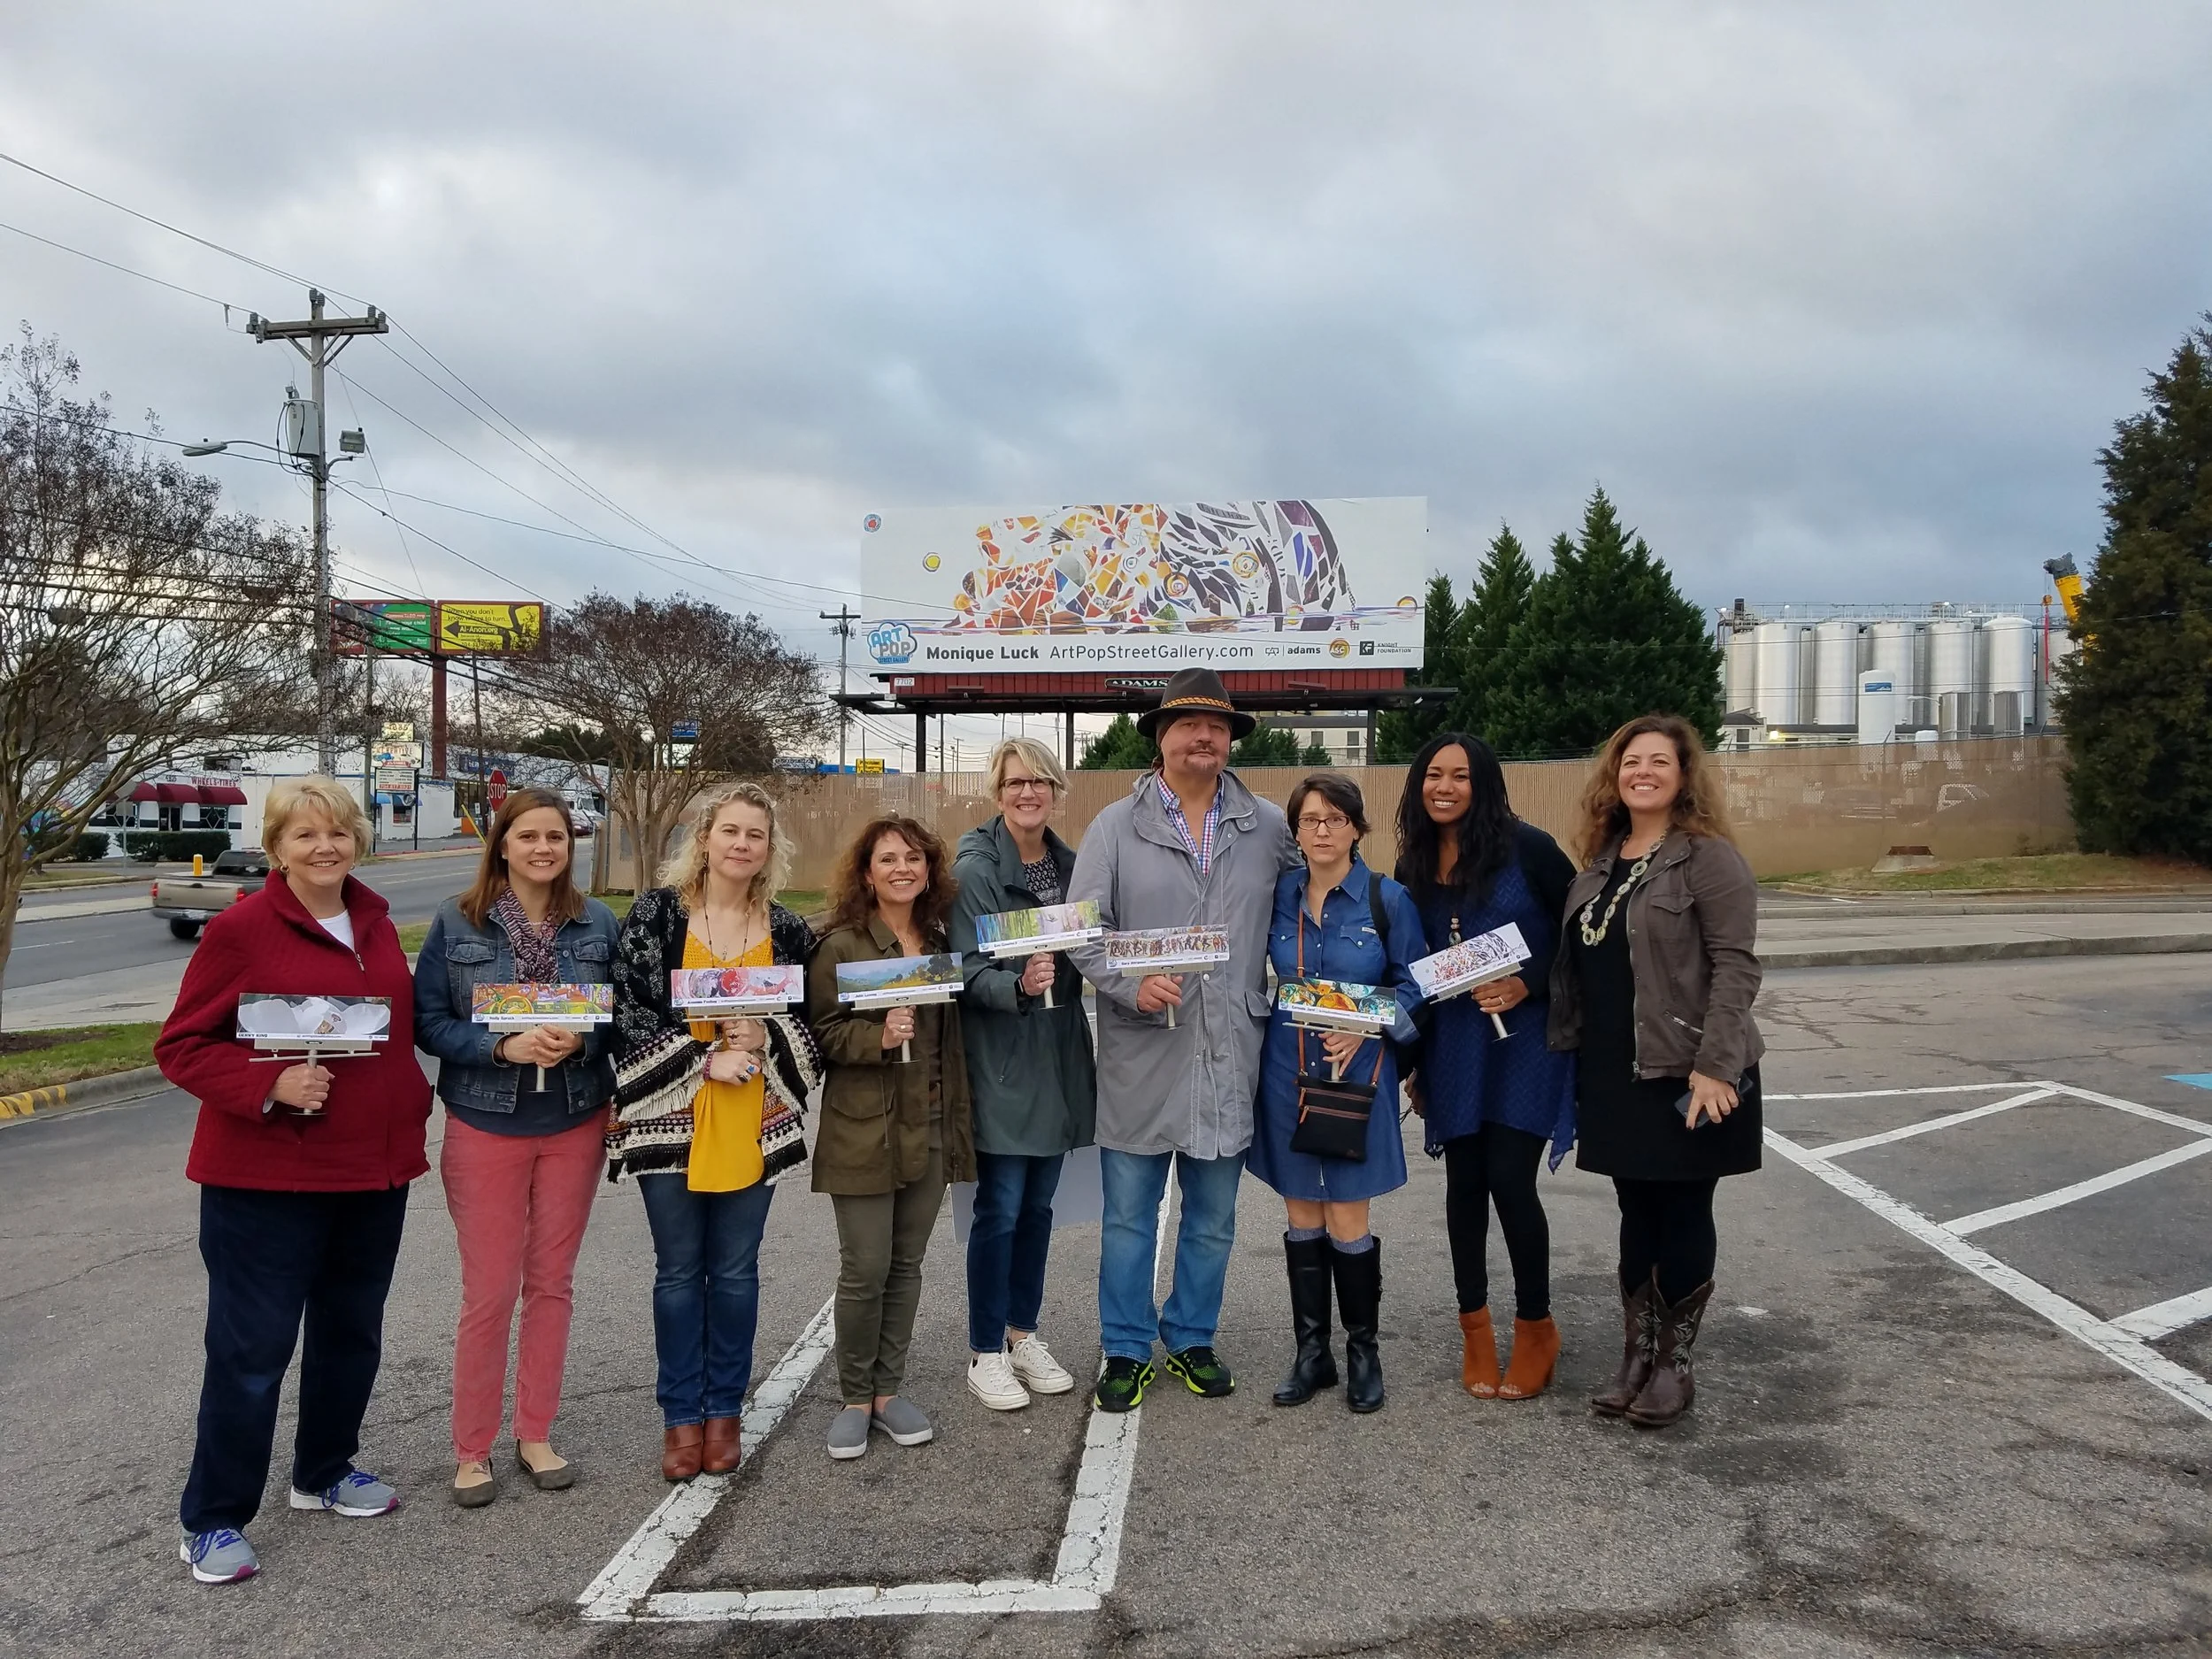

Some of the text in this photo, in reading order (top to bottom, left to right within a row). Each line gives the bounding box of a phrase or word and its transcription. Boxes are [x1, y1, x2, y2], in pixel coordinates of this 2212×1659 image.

[871, 627, 902, 648] ART
[926, 646, 1040, 662] Monique Luck
[1049, 644, 1254, 661] ArtPopStreetGallery.com
[1287, 646, 1321, 655] adams
[489, 783, 506, 799] STOP
